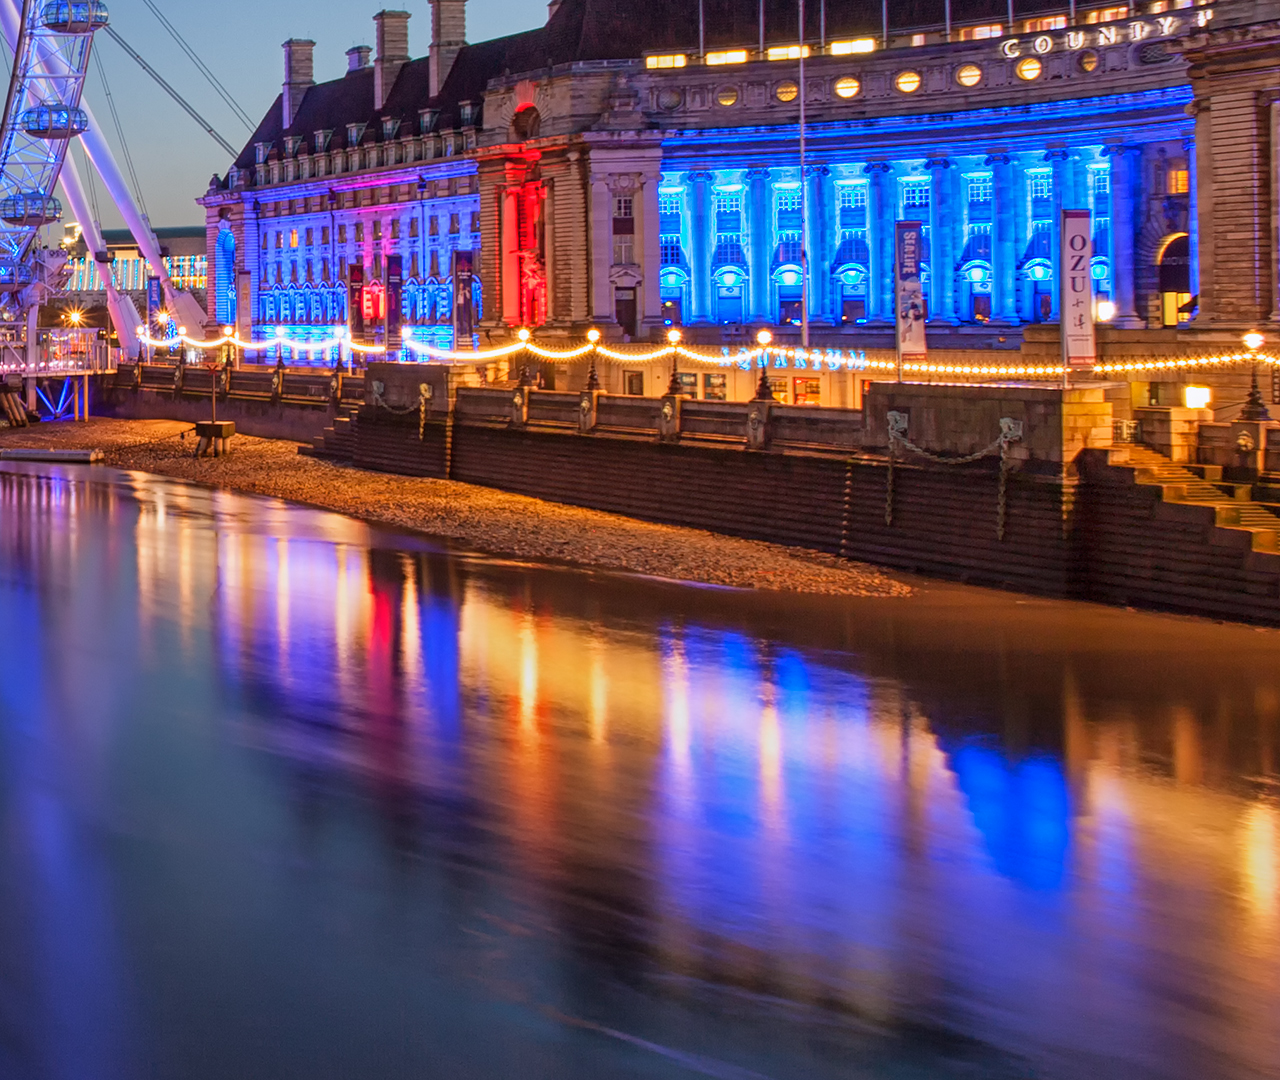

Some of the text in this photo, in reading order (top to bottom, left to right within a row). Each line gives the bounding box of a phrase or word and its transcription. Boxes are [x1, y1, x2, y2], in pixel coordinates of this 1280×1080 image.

[1002, 16, 1176, 58] COUNTY
[902, 232, 917, 274] SEA LIFE
[1069, 234, 1087, 293] OZU
